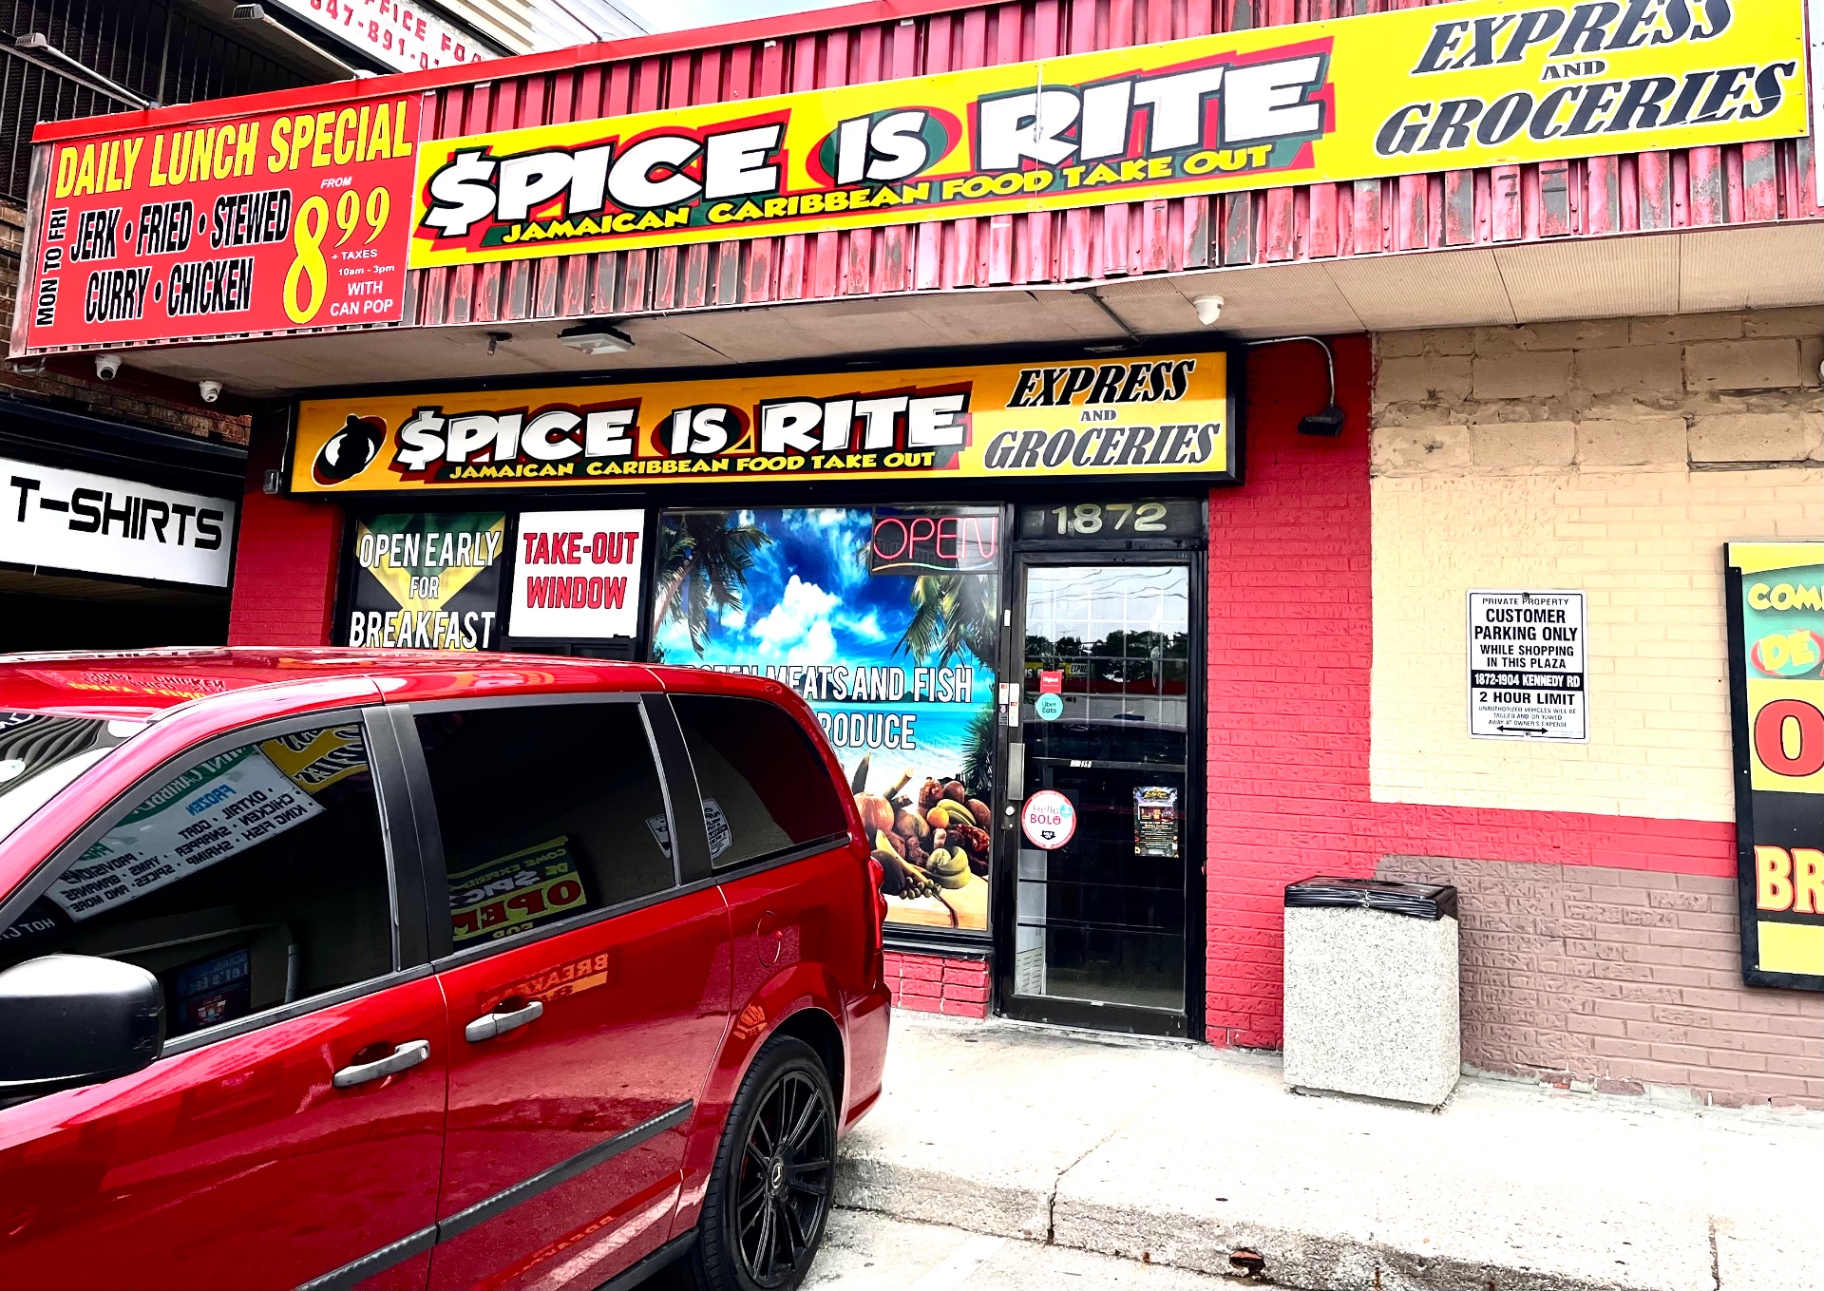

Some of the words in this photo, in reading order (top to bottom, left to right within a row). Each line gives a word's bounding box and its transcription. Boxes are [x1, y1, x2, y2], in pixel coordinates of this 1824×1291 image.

[1412, 0, 1731, 74] EXPRESS
[1541, 60, 1605, 80] AND
[836, 110, 930, 187] IS
[978, 54, 1323, 169] RITE
[1376, 62, 1796, 156] GROCERIES
[55, 137, 144, 199] DAILY
[149, 122, 260, 187] LUNCH
[267, 100, 413, 173] SPECIAL
[320, 176, 352, 189] FROM
[502, 206, 690, 243] JAMAICAN
[708, 181, 929, 226] CARIBBEAN
[942, 170, 1054, 199] FOOD
[1063, 158, 1173, 186] TAKE
[1184, 144, 1273, 174] OUT
[47, 207, 69, 241] FRI
[70, 208, 122, 262] JERK
[135, 200, 193, 256] FRIED
[211, 188, 292, 249] STEWED
[44, 248, 63, 273] TO
[338, 267, 364, 276] 10am
[373, 265, 395, 274] 3pm
[341, 249, 378, 260] TAXES
[35, 278, 59, 327] MON
[85, 266, 152, 323] CURRY
[167, 257, 254, 317] CHICKEN
[347, 280, 383, 296] WITH
[330, 302, 360, 317] CAN
[363, 299, 393, 314] POP
[1006, 359, 1195, 409] EXPRESS
[671, 407, 728, 455] IS
[761, 394, 965, 454] RITE
[1080, 410, 1117, 421] AND
[984, 423, 1221, 470] GROCERIES
[449, 462, 574, 480] JAMAICAN
[586, 458, 728, 476] CARIBBEAN
[737, 456, 804, 472] FOOD
[810, 453, 877, 470] TAKE
[884, 451, 936, 467] OUT
[10, 476, 224, 550] T-SHIRTS
[1052, 503, 1167, 535] 1872
[359, 532, 419, 568] OPEN
[424, 530, 502, 567] EARLY
[523, 532, 639, 565] TAKE-OUT
[873, 517, 997, 560] OPEN
[409, 576, 439, 599] FOR
[527, 576, 627, 610] WINDOW
[1522, 598, 1569, 606] PROPERTY
[1748, 583, 1824, 611] COM
[350, 611, 496, 649] BREAKFAST
[1486, 608, 1566, 623] CUSTOMER
[1474, 626, 1536, 640] PARKING
[1542, 627, 1578, 641] ONLY
[1480, 645, 1514, 655] WHILE
[1518, 645, 1574, 656] SHOPPING
[1487, 657, 1497, 667] IN
[1502, 657, 1526, 668] THIS
[1530, 658, 1566, 668] PLAZA
[1760, 630, 1815, 671] DE
[852, 667, 905, 703] AND
[913, 666, 972, 704] FISH
[1474, 673, 1520, 685] 1872-1904
[1522, 674, 1564, 687] KENNEDY
[1567, 675, 1580, 687] RD
[1479, 691, 1488, 702] 2
[1493, 692, 1531, 704] HOUR
[1537, 693, 1575, 705] LIMIT
[816, 711, 917, 750] RODUCE
